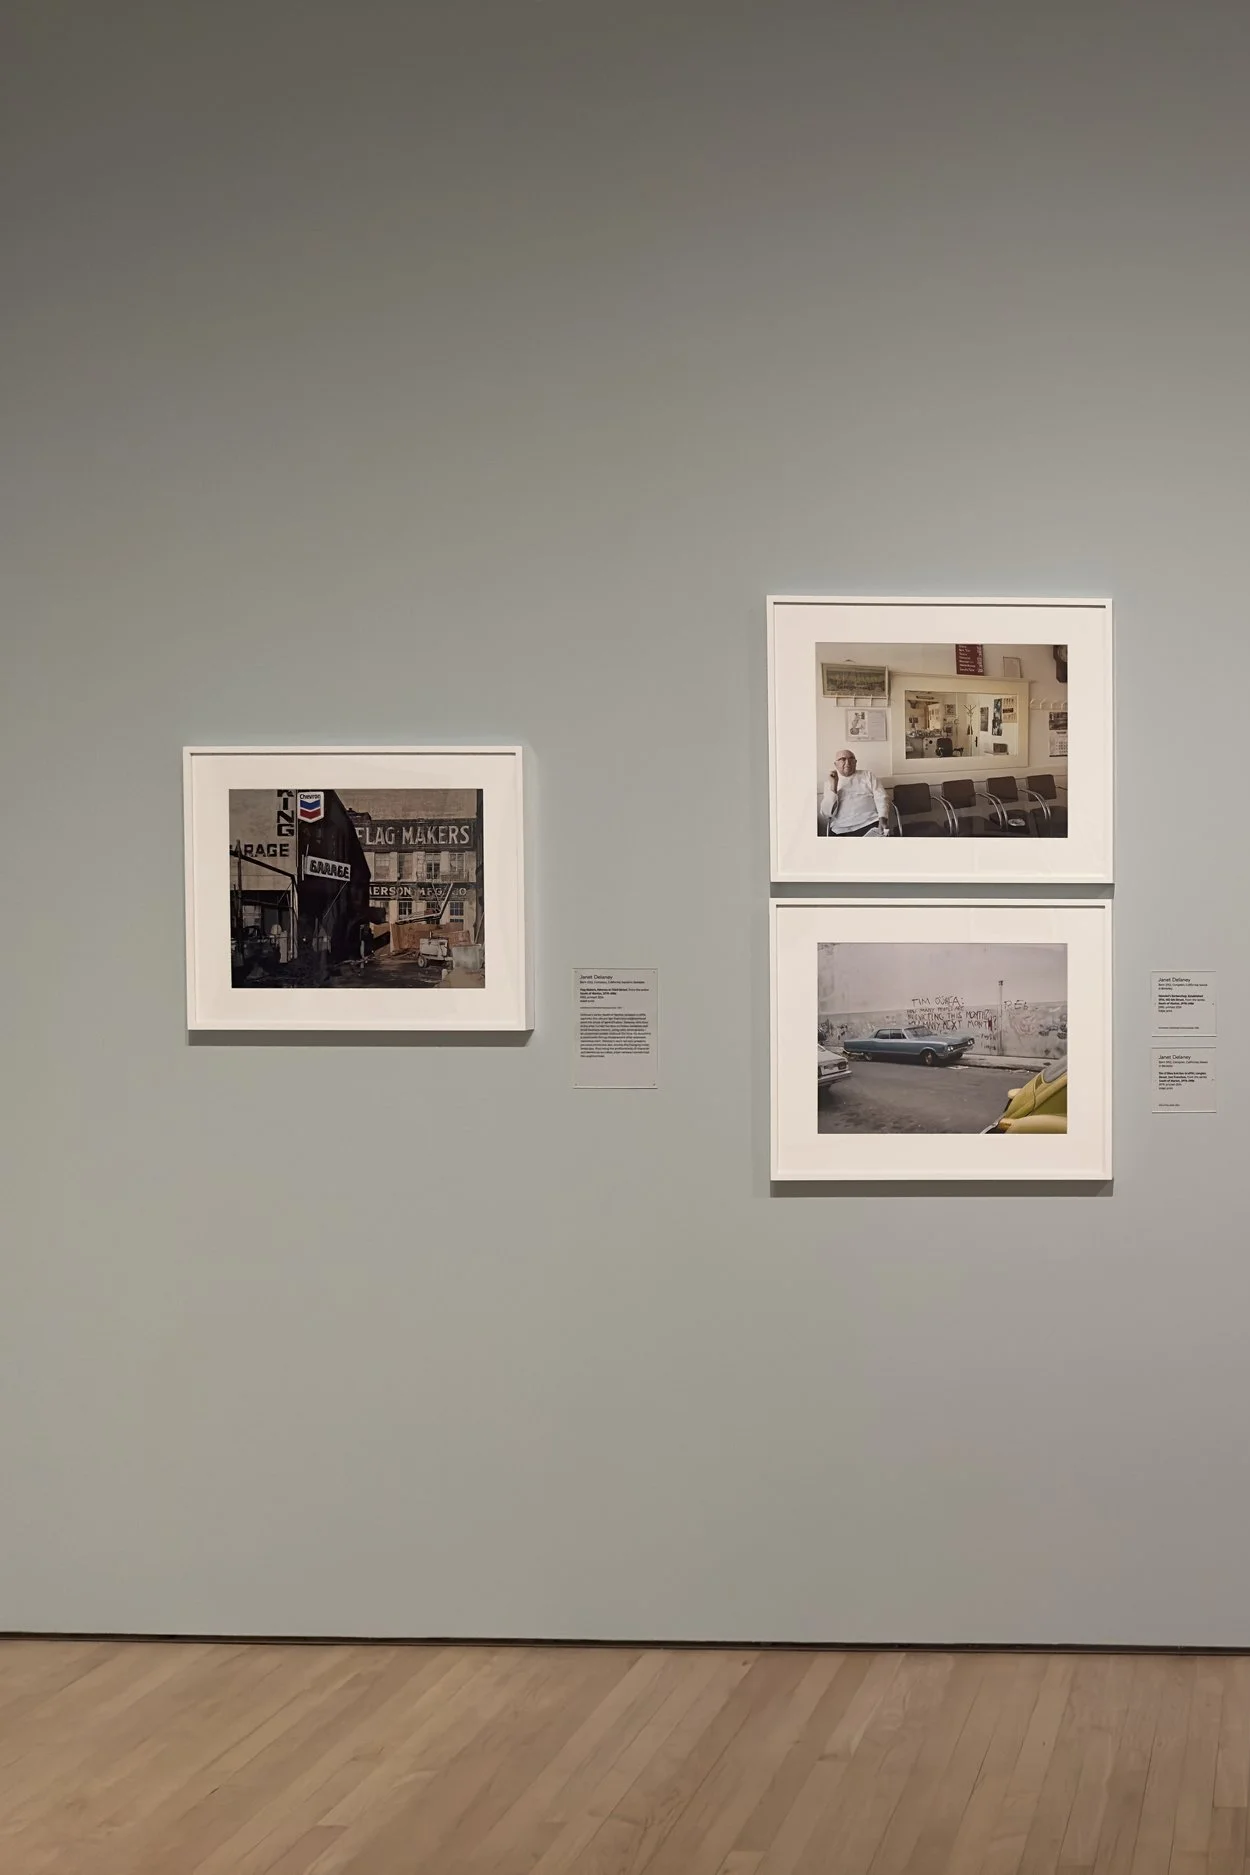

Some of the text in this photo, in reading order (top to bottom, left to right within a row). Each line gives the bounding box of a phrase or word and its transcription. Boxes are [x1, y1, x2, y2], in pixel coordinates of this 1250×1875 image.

[355, 825, 470, 845] FLAG MAKERS
[310, 859, 349, 879] GARAGE
[912, 997, 930, 1007] TIM
[947, 1011, 963, 1020] THIS
